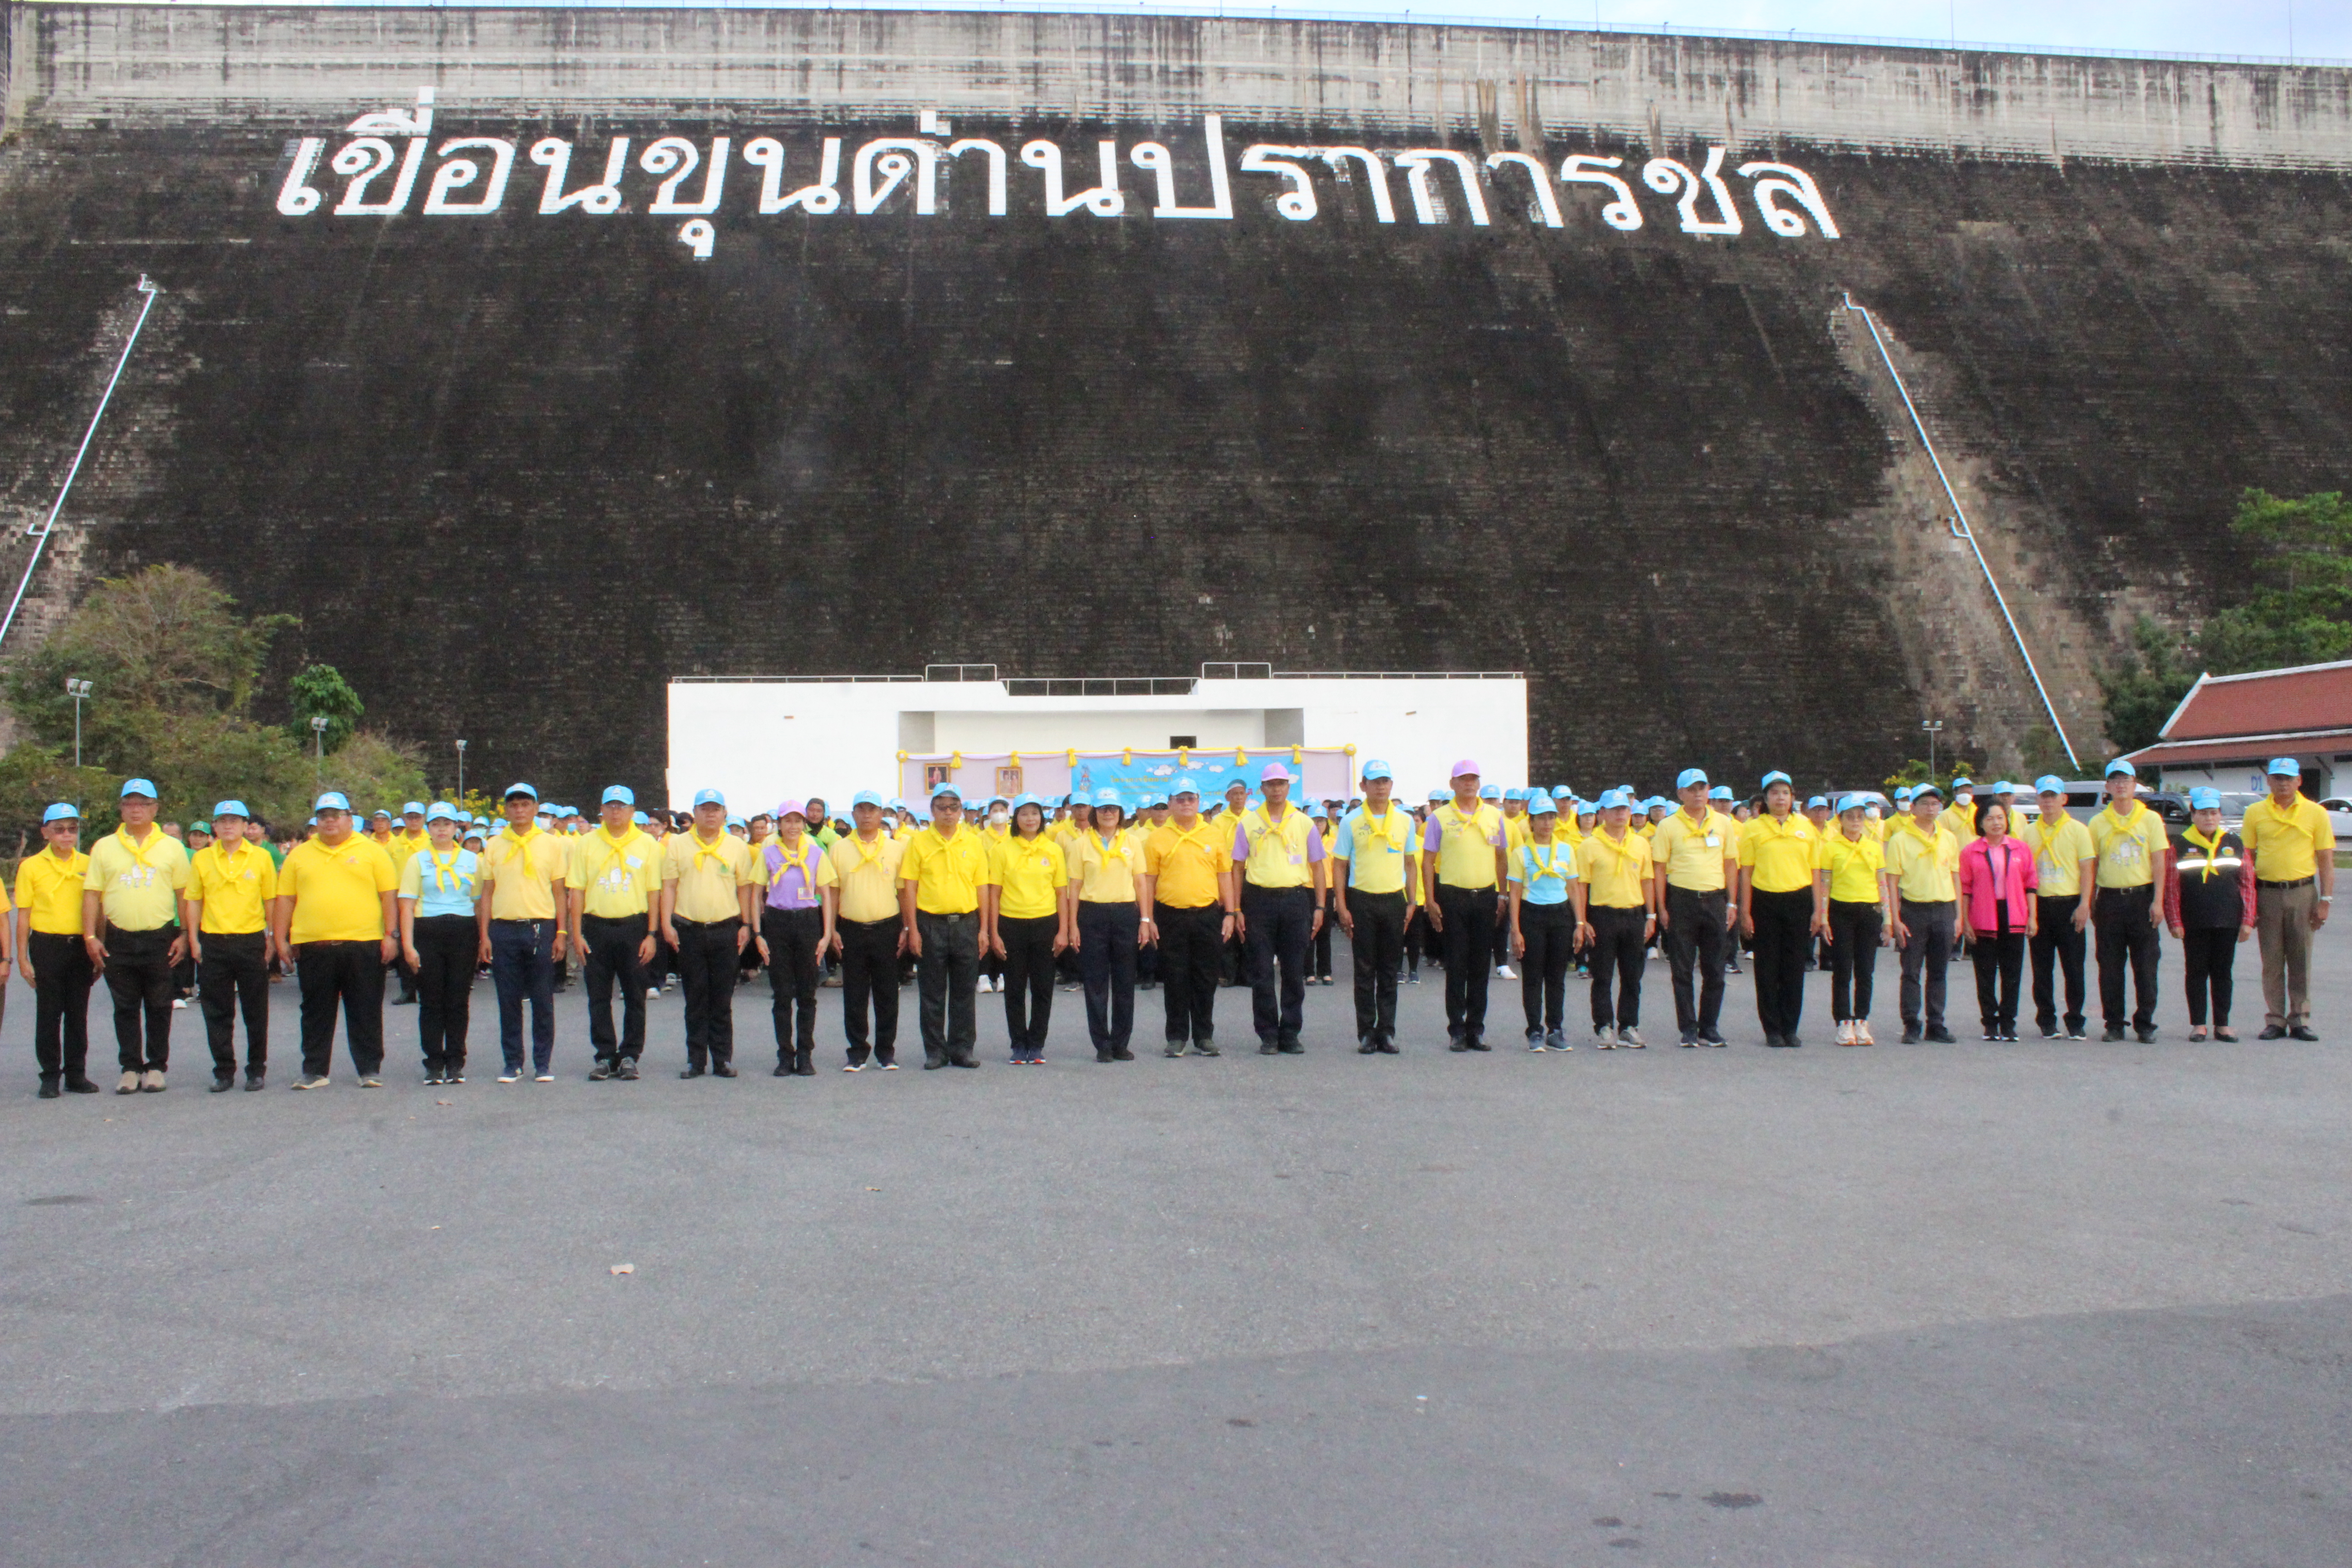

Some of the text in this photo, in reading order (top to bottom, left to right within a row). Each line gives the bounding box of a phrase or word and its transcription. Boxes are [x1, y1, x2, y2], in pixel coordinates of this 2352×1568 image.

[276, 86, 1841, 257] เขื่อนขุนด่านปราการชล
[2251, 775, 2263, 791] D1
